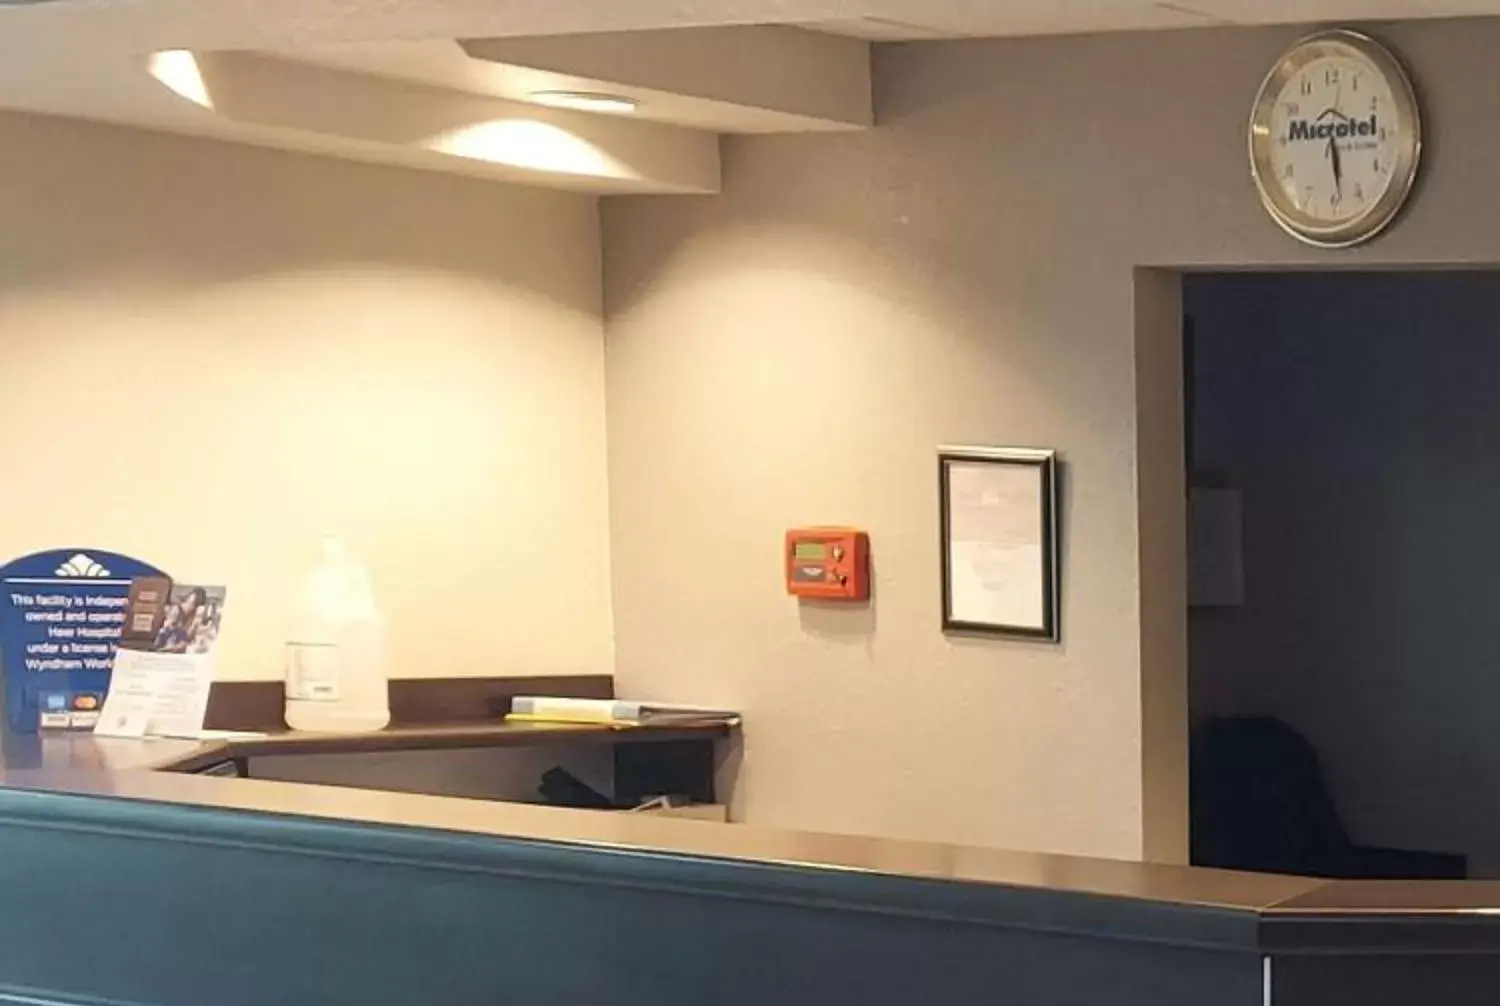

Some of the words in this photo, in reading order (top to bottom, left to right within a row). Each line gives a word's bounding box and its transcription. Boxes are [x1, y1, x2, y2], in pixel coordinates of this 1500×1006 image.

[1288, 115, 1377, 142] Microtel
[11, 593, 34, 606] This
[36, 594, 73, 608] facility
[25, 610, 63, 622] owned
[65, 610, 87, 622] and
[27, 642, 59, 653] under
[25, 658, 82, 671] Wyndham
